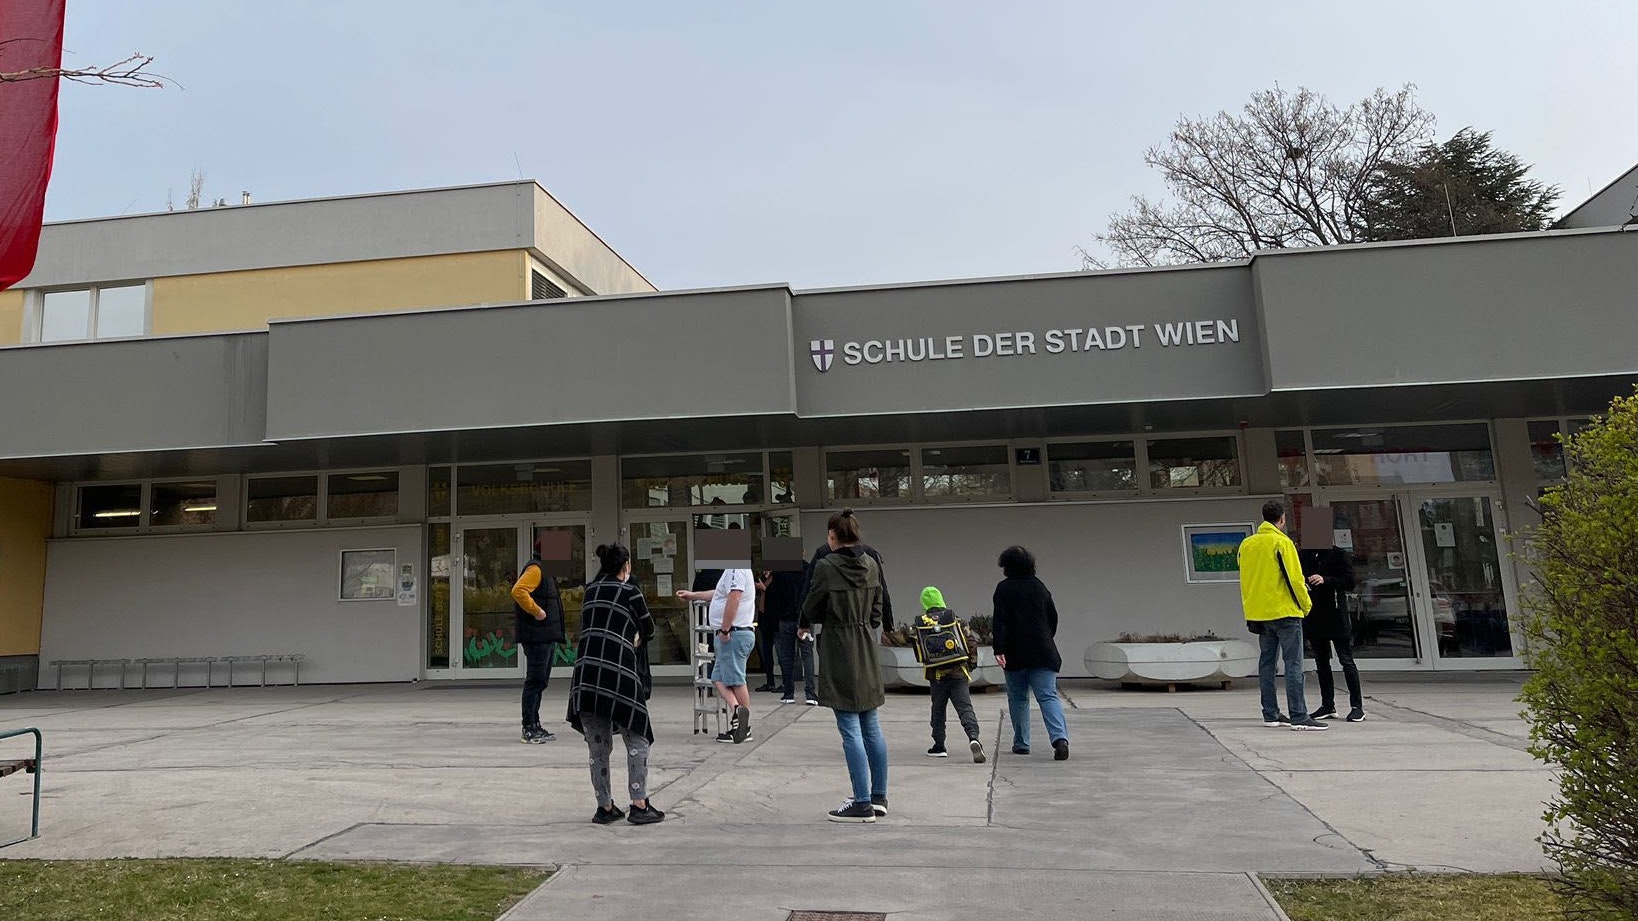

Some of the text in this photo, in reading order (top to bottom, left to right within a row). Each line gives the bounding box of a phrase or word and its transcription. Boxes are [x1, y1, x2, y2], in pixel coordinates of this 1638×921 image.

[843, 319, 1239, 364] SCHULE DER STADT WIEN
[1024, 450, 1031, 460] 7
[435, 613, 443, 655] SCHULE
